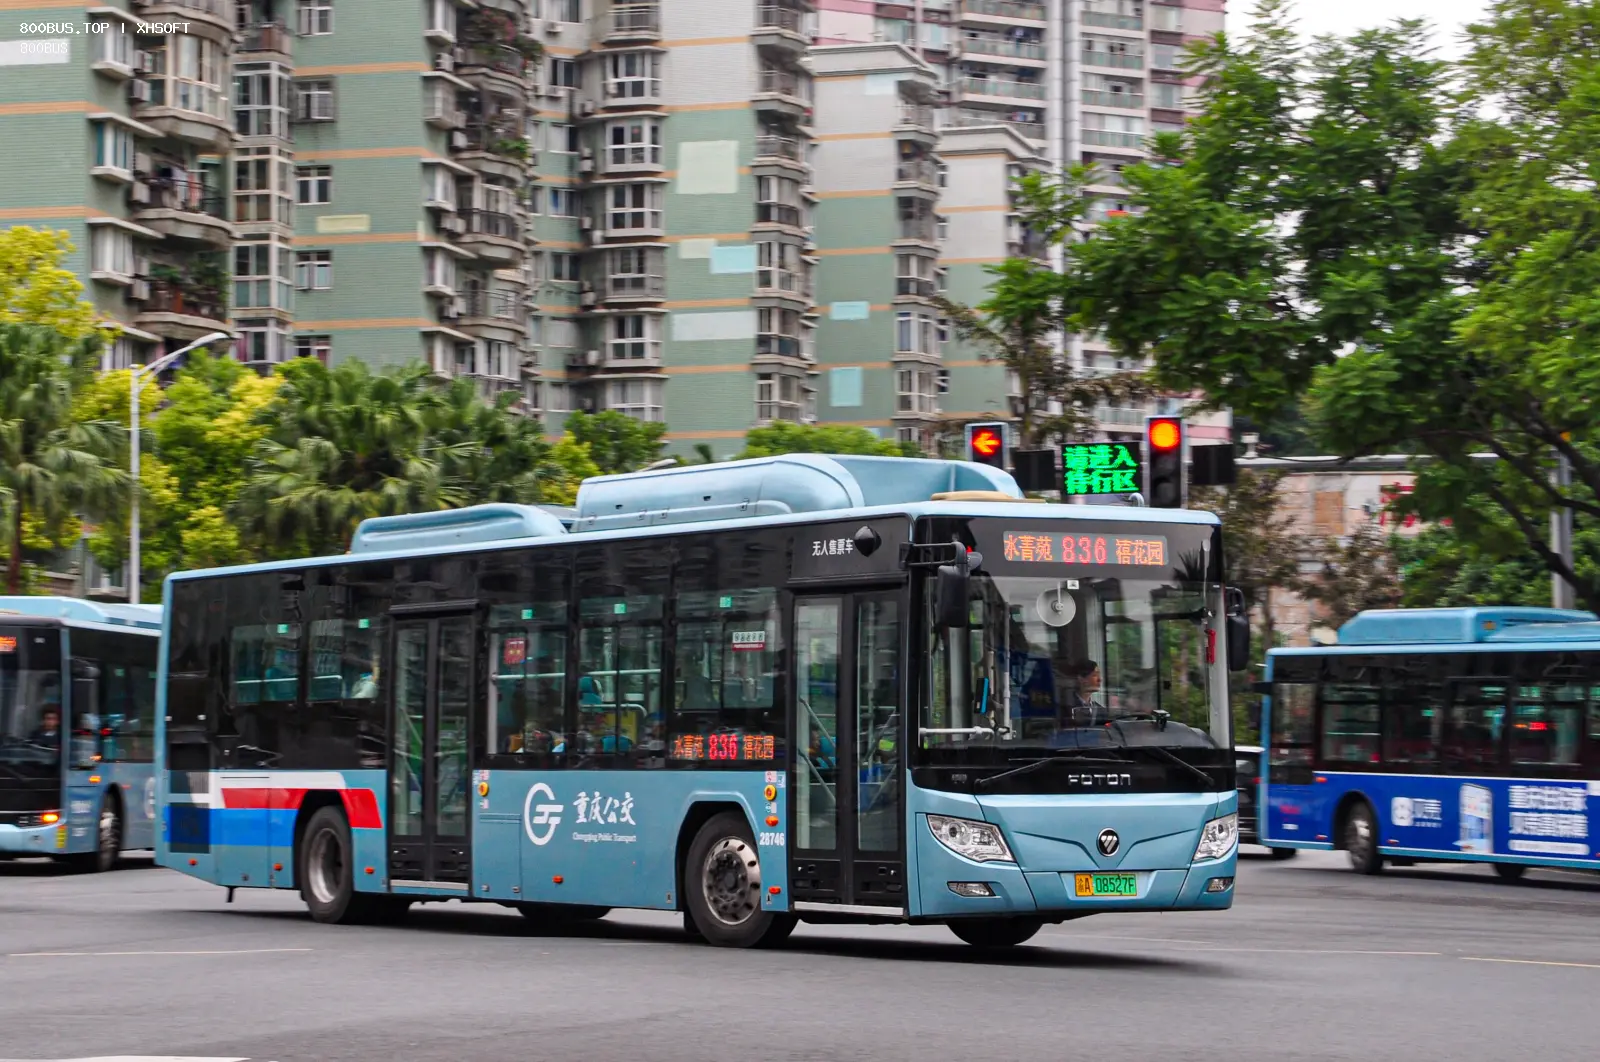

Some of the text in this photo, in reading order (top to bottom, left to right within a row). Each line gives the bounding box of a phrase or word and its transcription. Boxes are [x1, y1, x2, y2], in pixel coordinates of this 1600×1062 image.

[1063, 444, 1138, 469] 请进入
[812, 538, 854, 556] 无人售票车
[1003, 534, 1053, 562] 水菁苑
[1061, 535, 1108, 565] 836
[708, 733, 738, 760] 836
[1068, 774, 1131, 786] FOTON
[572, 791, 637, 826] 重庆公交
[759, 831, 785, 846] 28746
